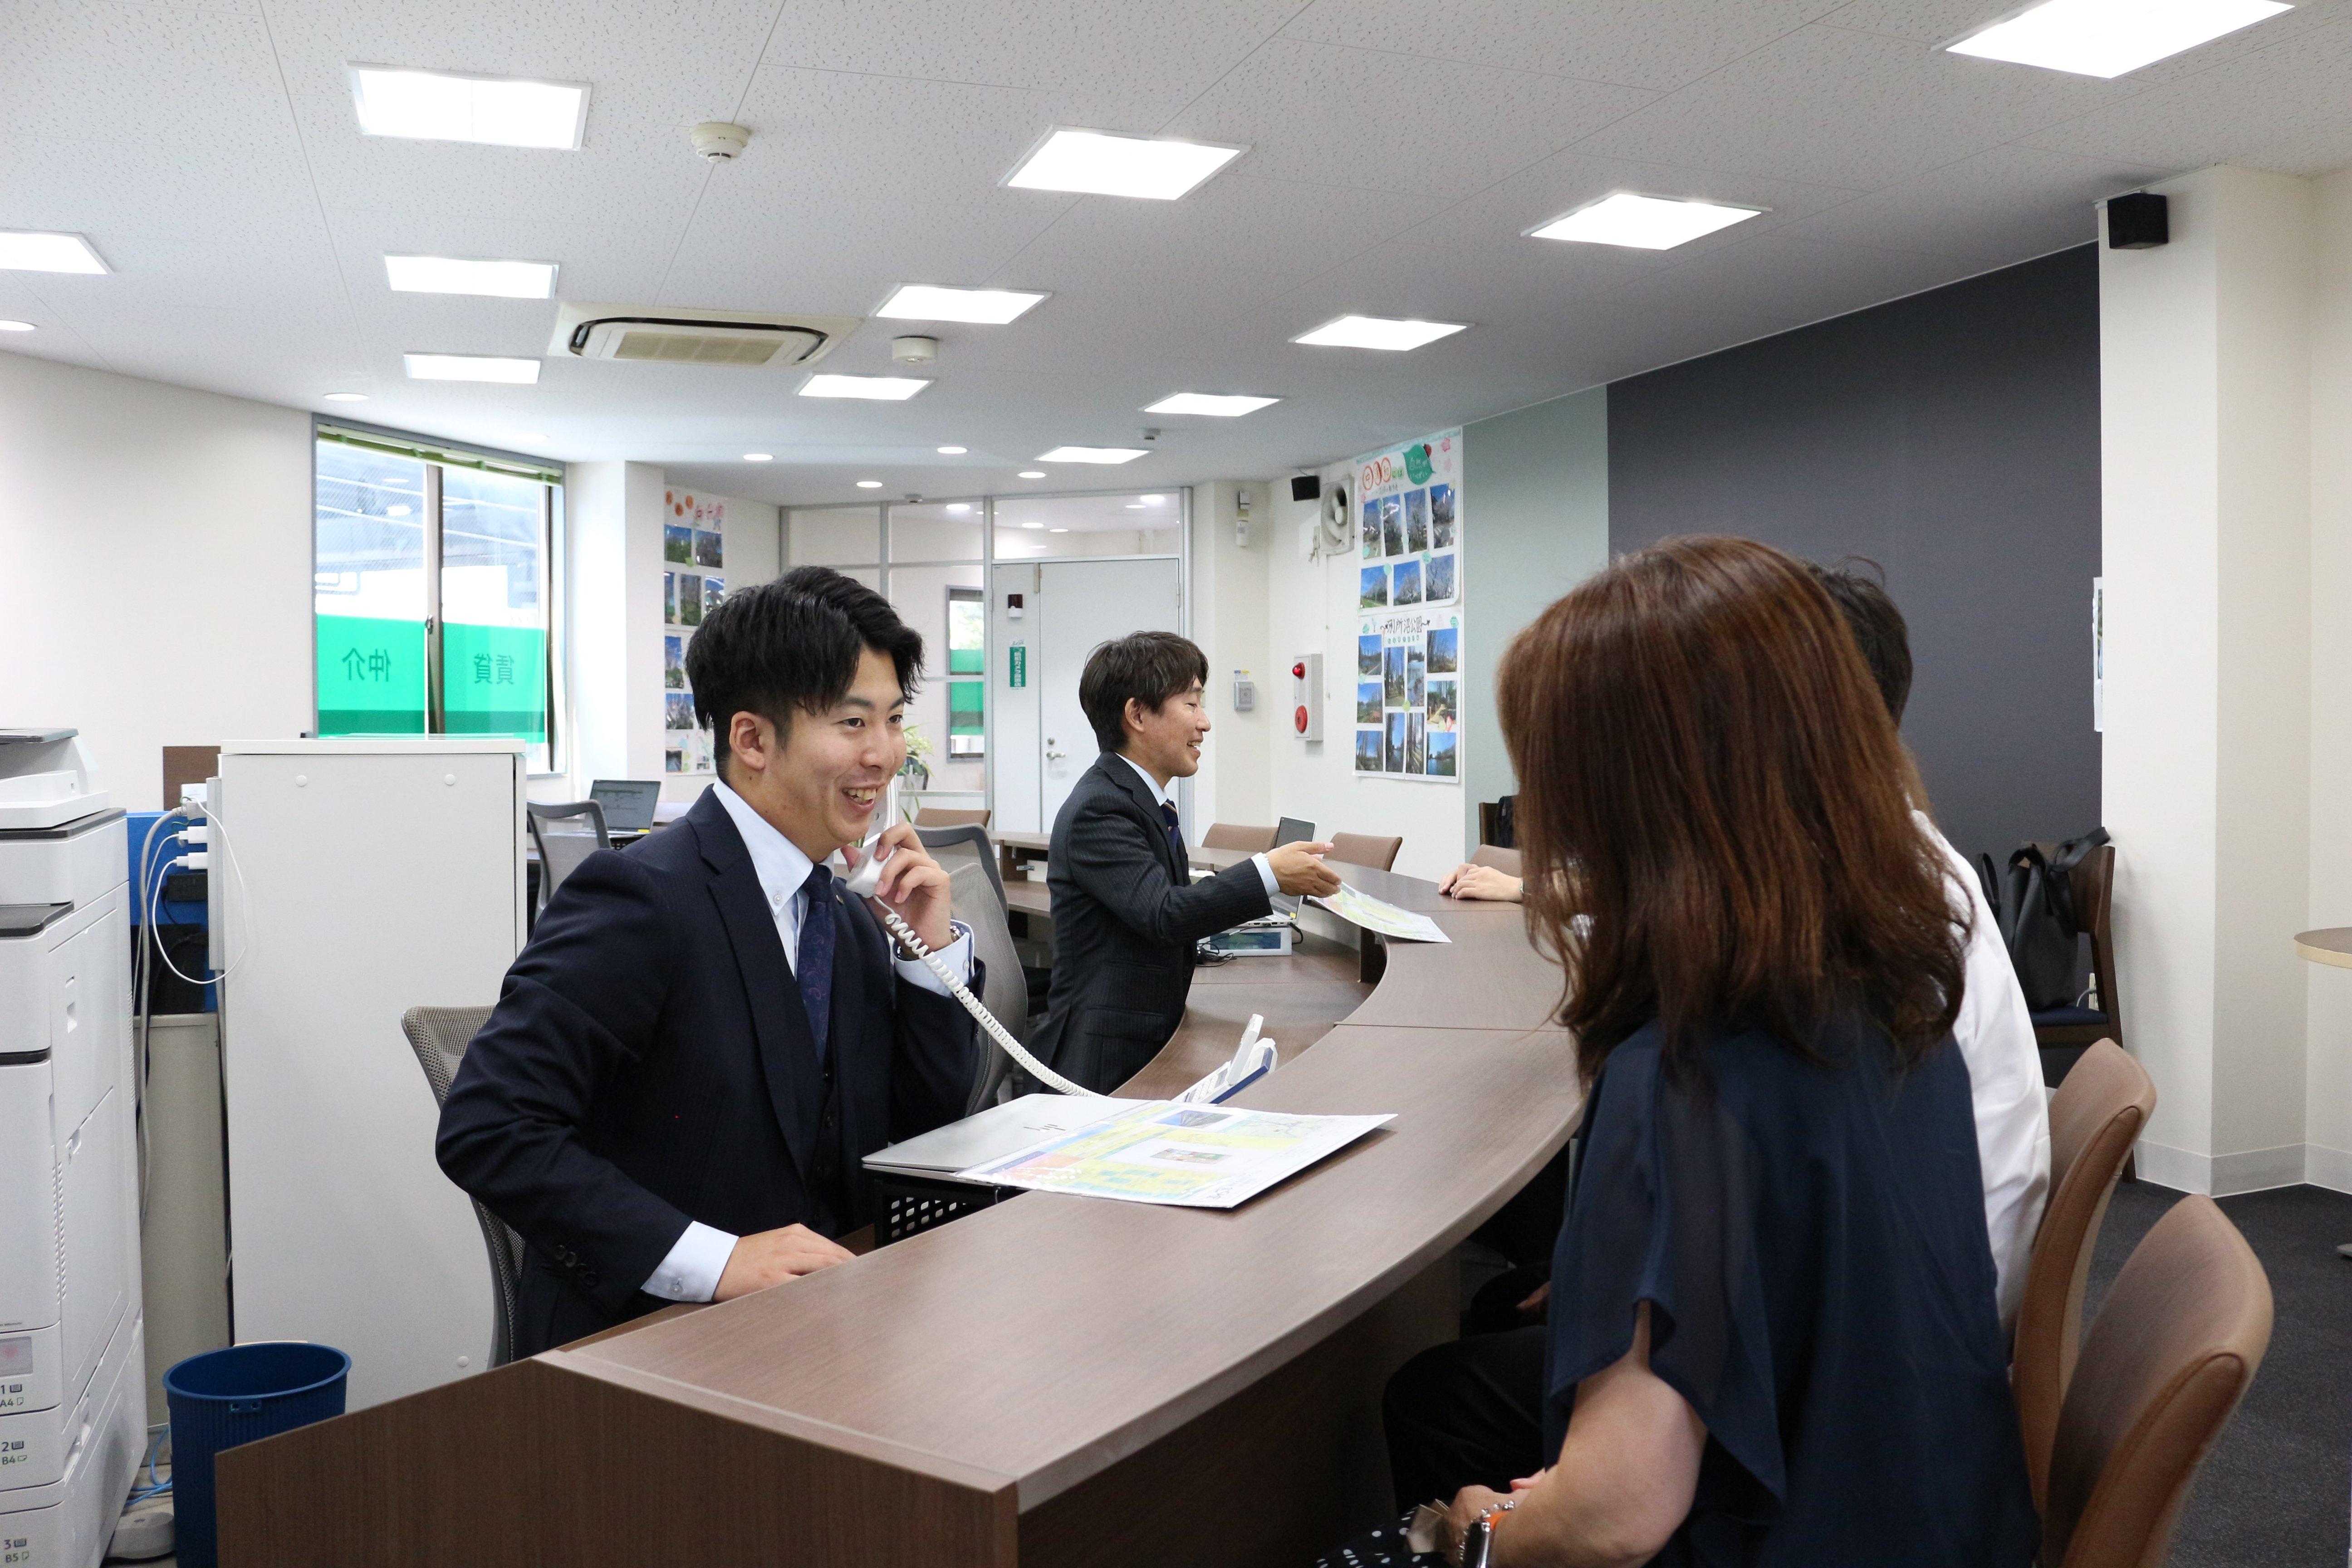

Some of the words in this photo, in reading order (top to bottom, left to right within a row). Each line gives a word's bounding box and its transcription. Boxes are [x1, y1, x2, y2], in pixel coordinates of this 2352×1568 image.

[1387, 616, 1422, 634] 別所沼公園
[0, 1385, 5, 1394] 1
[0, 1398, 14, 1407] A4
[1, 1441, 9, 1452] 2
[2, 1455, 16, 1465] B4
[4, 1539, 11, 1550] 3
[5, 1553, 19, 1563] B5
